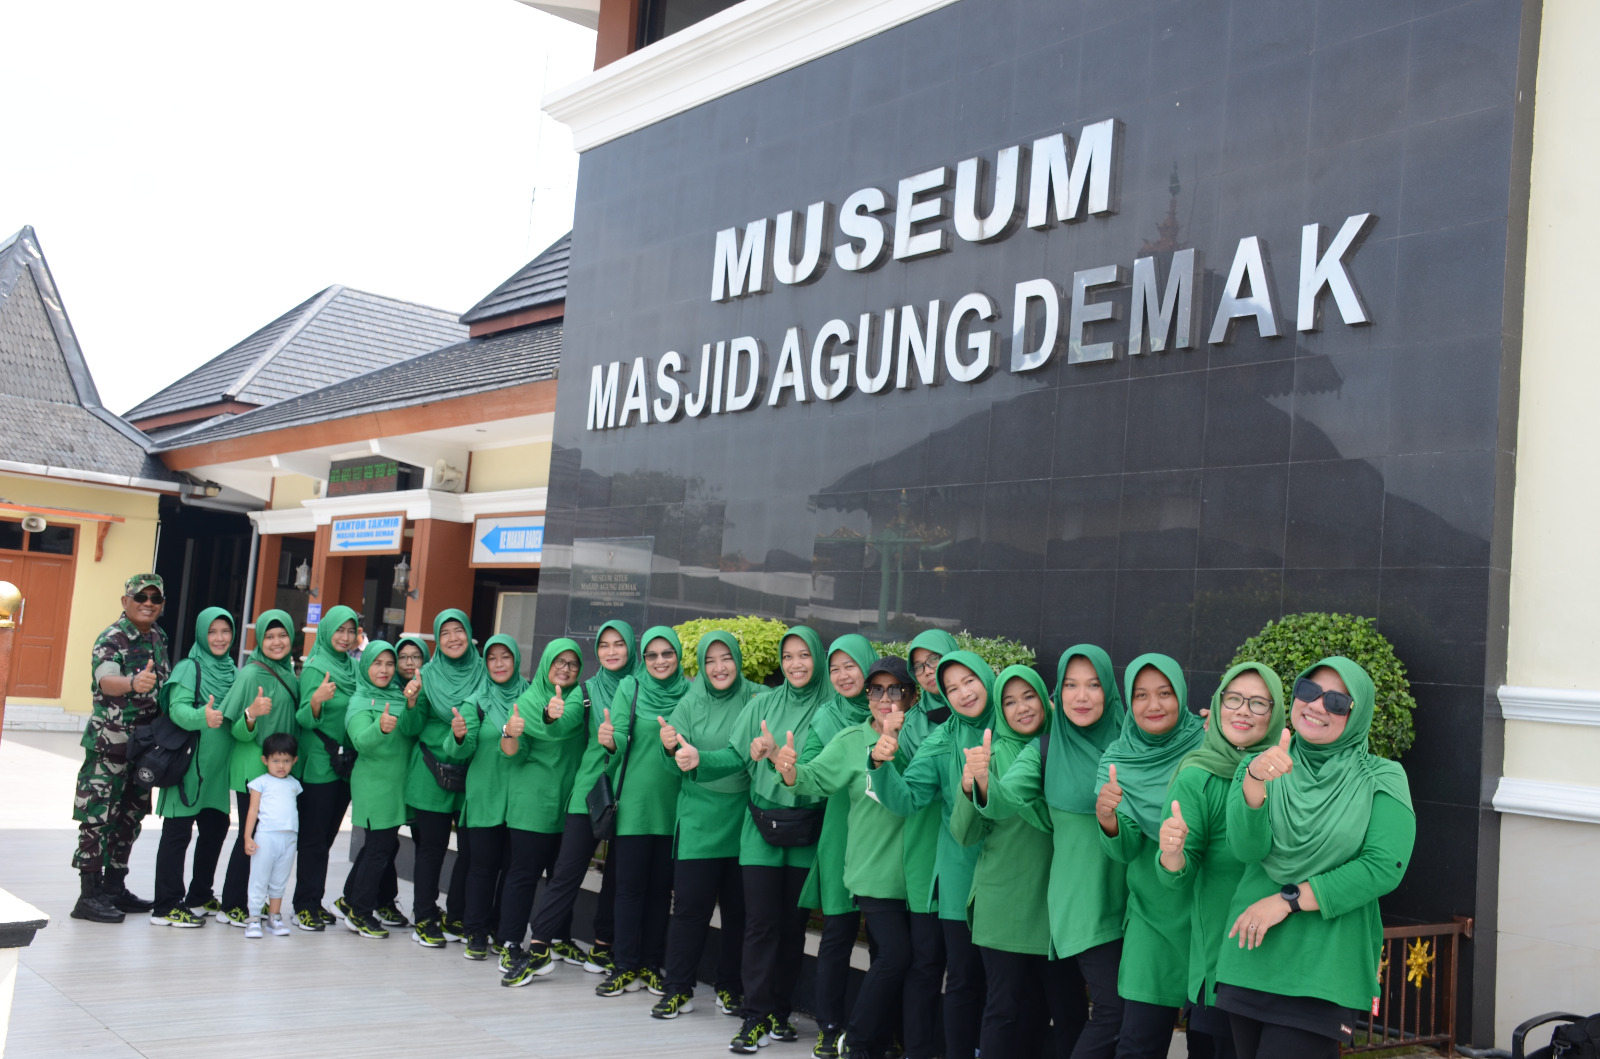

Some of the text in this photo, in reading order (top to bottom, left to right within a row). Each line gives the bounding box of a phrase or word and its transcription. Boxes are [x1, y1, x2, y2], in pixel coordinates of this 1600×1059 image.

[710, 118, 1122, 302] MUSEUM
[586, 212, 1378, 431] MASJID AGUNG DEMAK
[335, 517, 399, 532] KANTOR TAKMIR
[499, 530, 508, 550] KE
